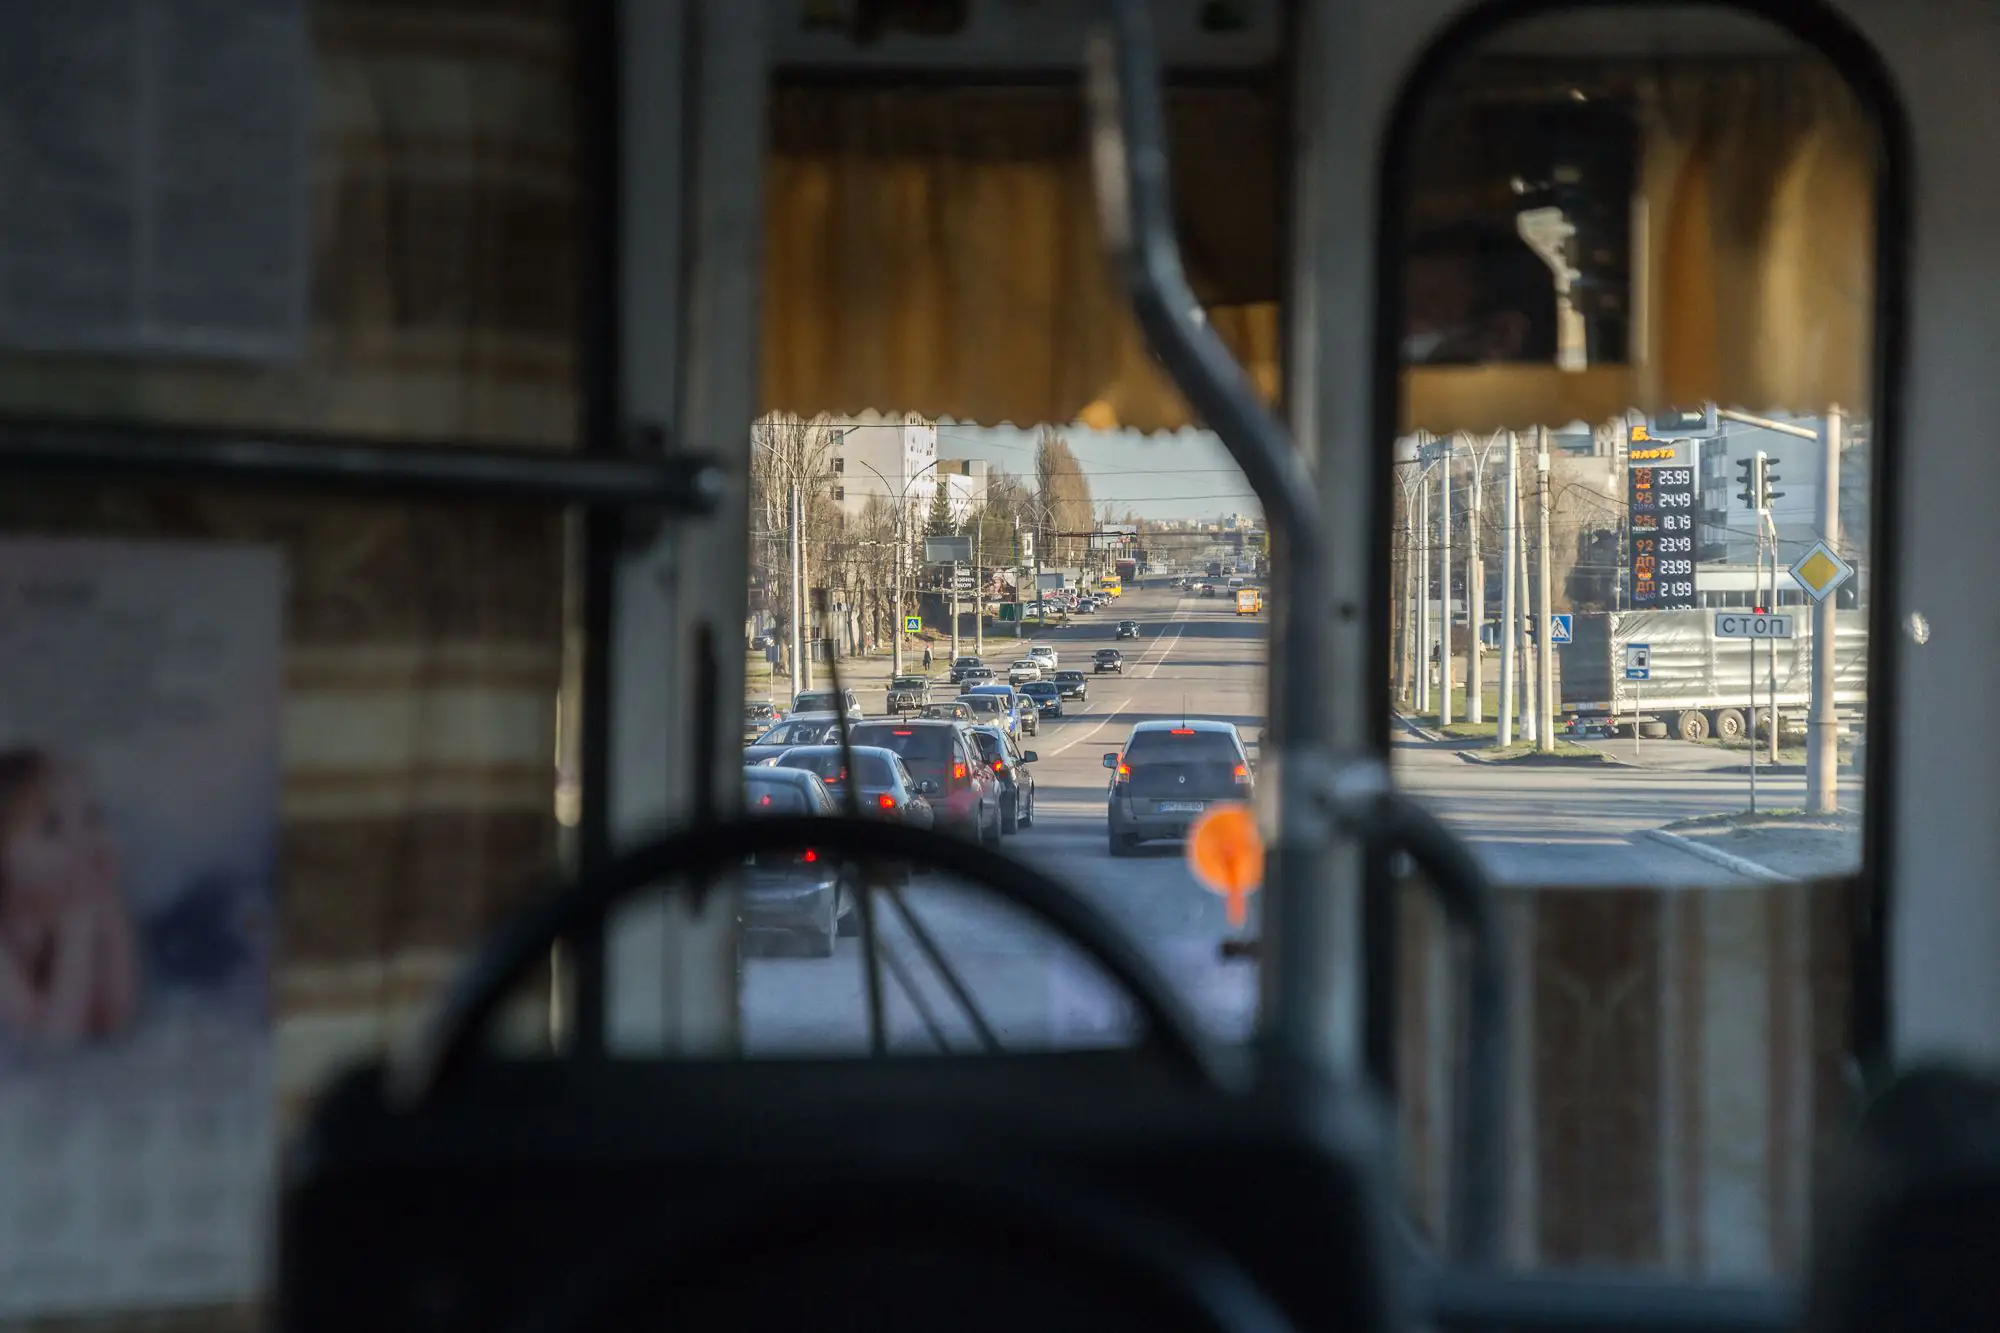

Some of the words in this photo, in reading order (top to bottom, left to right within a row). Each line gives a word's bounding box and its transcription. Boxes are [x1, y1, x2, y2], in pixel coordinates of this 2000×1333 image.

[1631, 449, 1676, 459] НАФТА
[1659, 470, 1690, 485] 25.99
[1636, 492, 1653, 503] 95
[1660, 493, 1691, 507] 24.49
[1663, 515, 1691, 530] 18.79
[1636, 539, 1654, 552] 92
[1660, 537, 1691, 552] 23.49
[1660, 559, 1692, 574] 23.99
[1660, 582, 1692, 597] 21.99
[1722, 617, 1783, 635] СТОП
